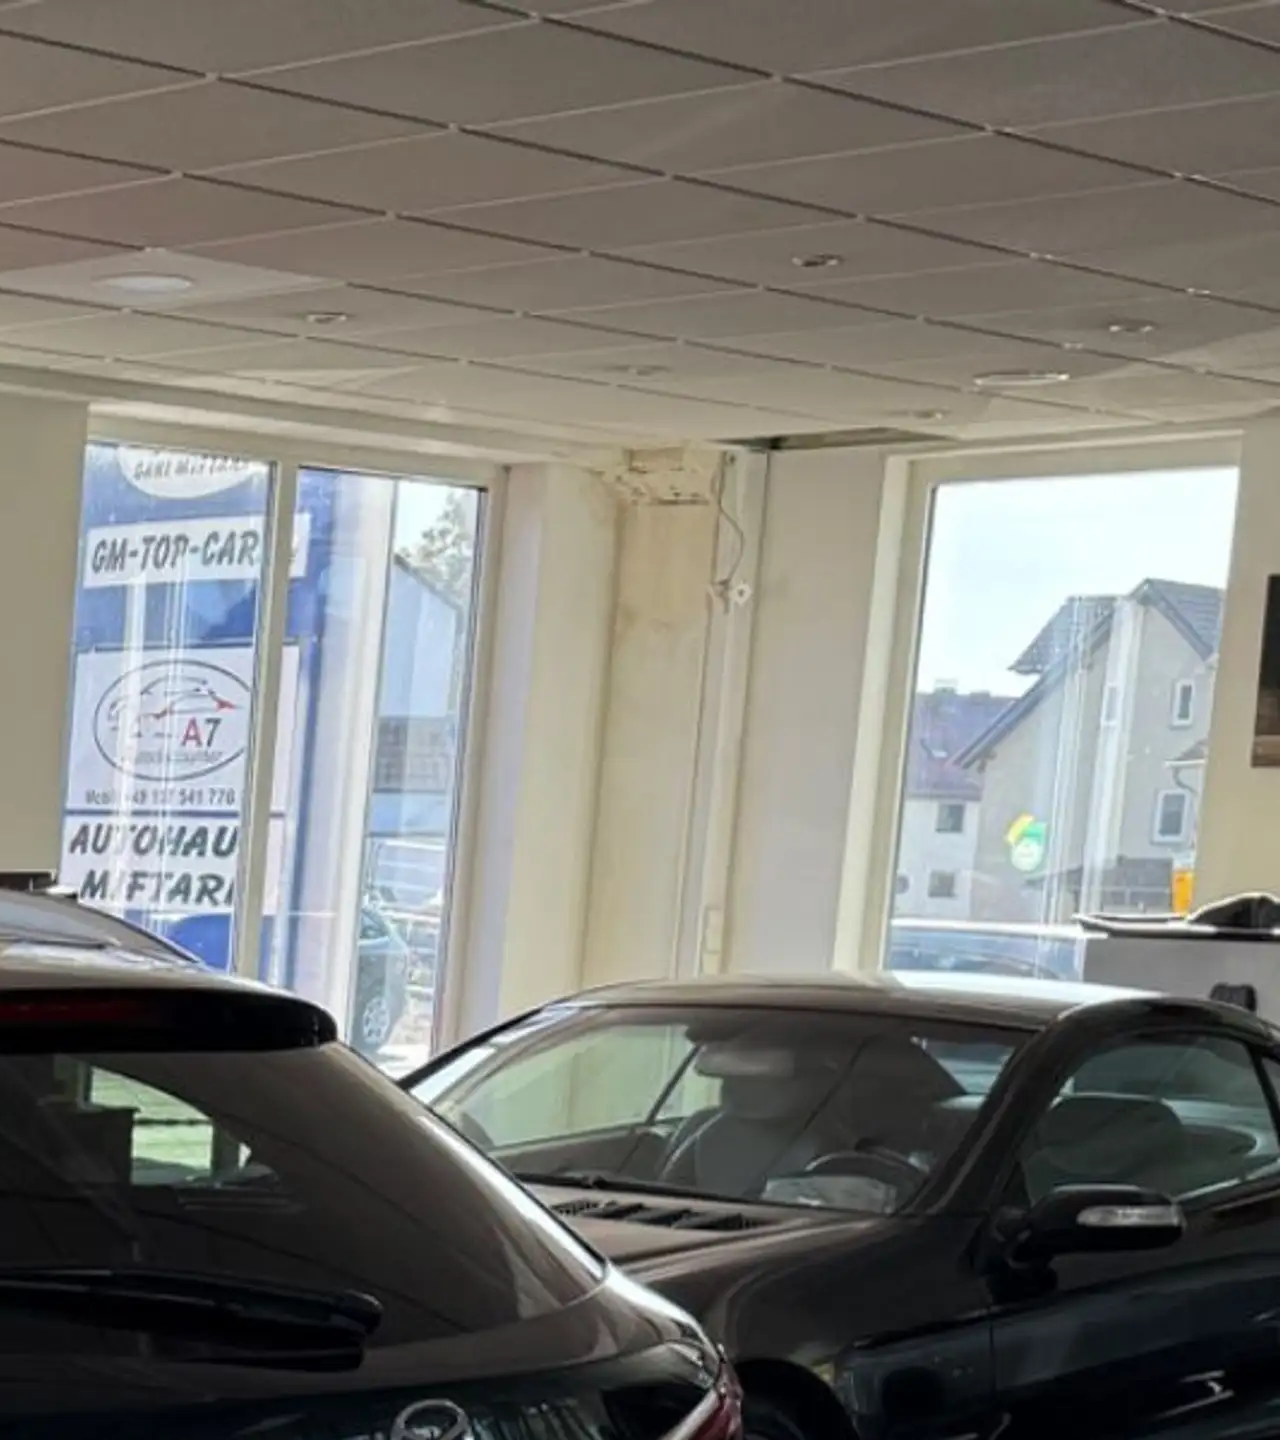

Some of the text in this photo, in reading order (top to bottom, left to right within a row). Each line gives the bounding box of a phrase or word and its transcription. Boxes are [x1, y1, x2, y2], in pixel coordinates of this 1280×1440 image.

[92, 530, 259, 574] GM-TOP-CAR
[70, 823, 238, 858] AUTOHAU
[80, 869, 236, 907] MFTARI
